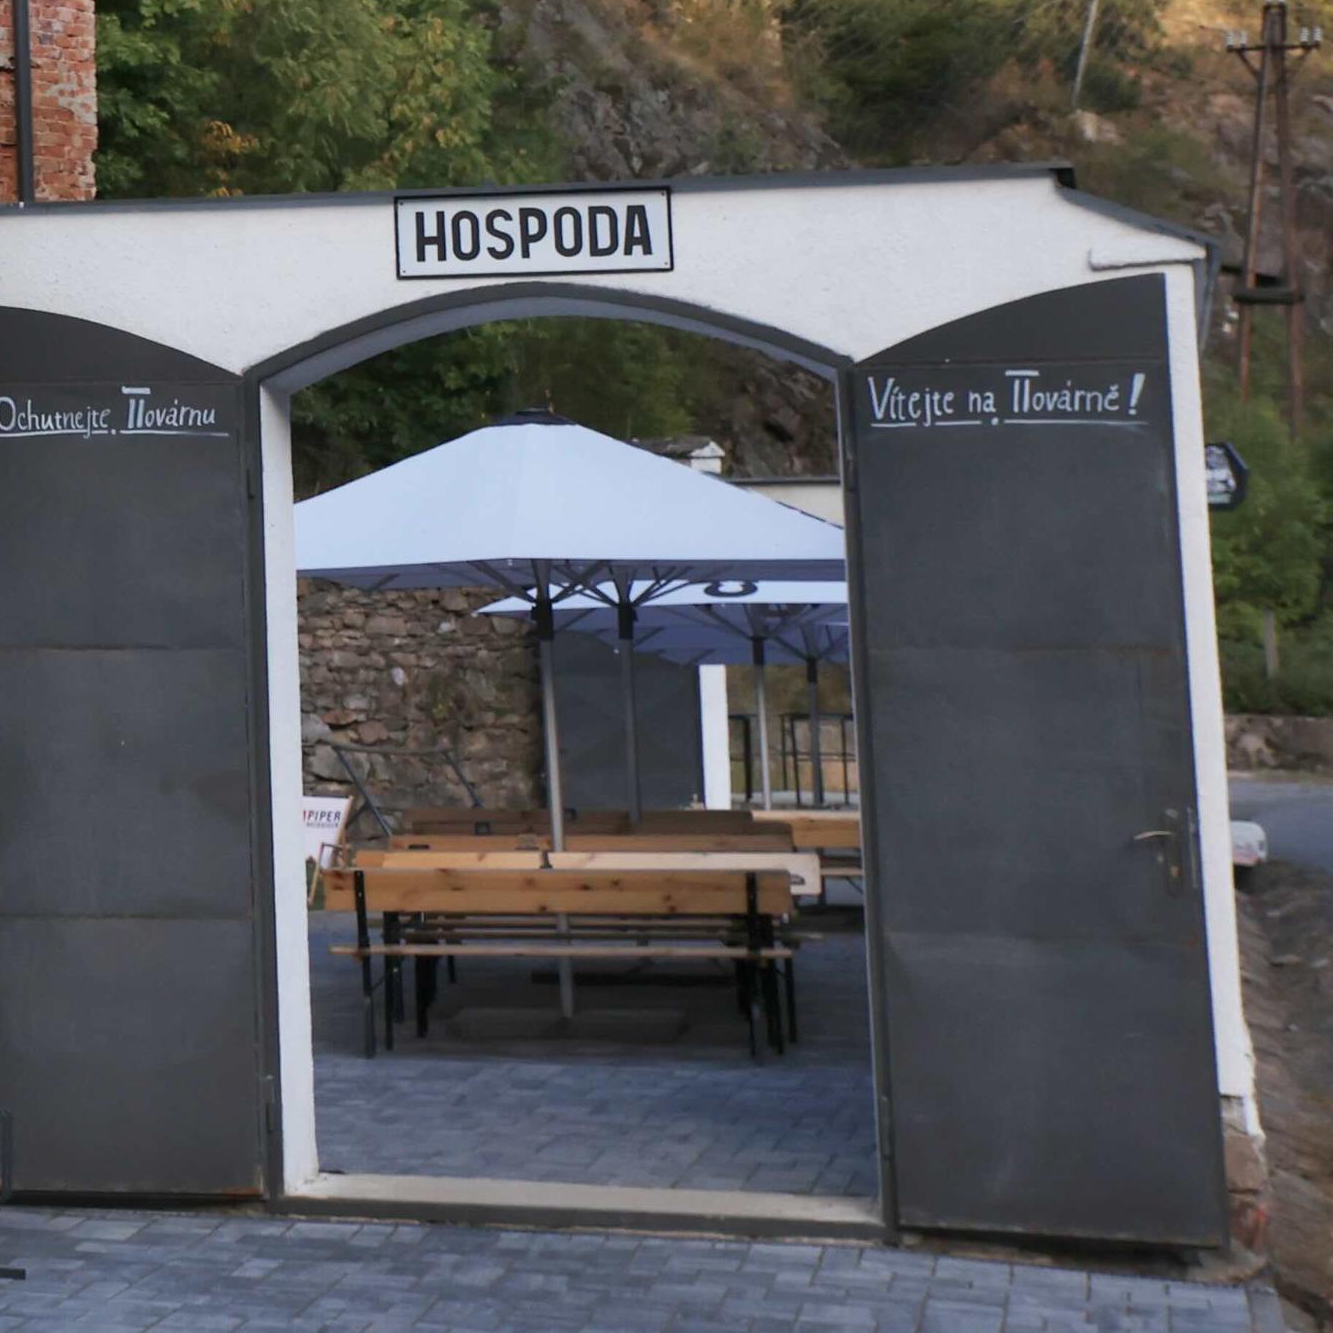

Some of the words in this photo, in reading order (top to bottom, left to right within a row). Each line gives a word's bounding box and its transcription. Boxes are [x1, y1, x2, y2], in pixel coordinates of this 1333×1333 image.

[414, 204, 653, 262] HOSPODA
[868, 376, 954, 427] Vítejte
[968, 390, 996, 413] na
